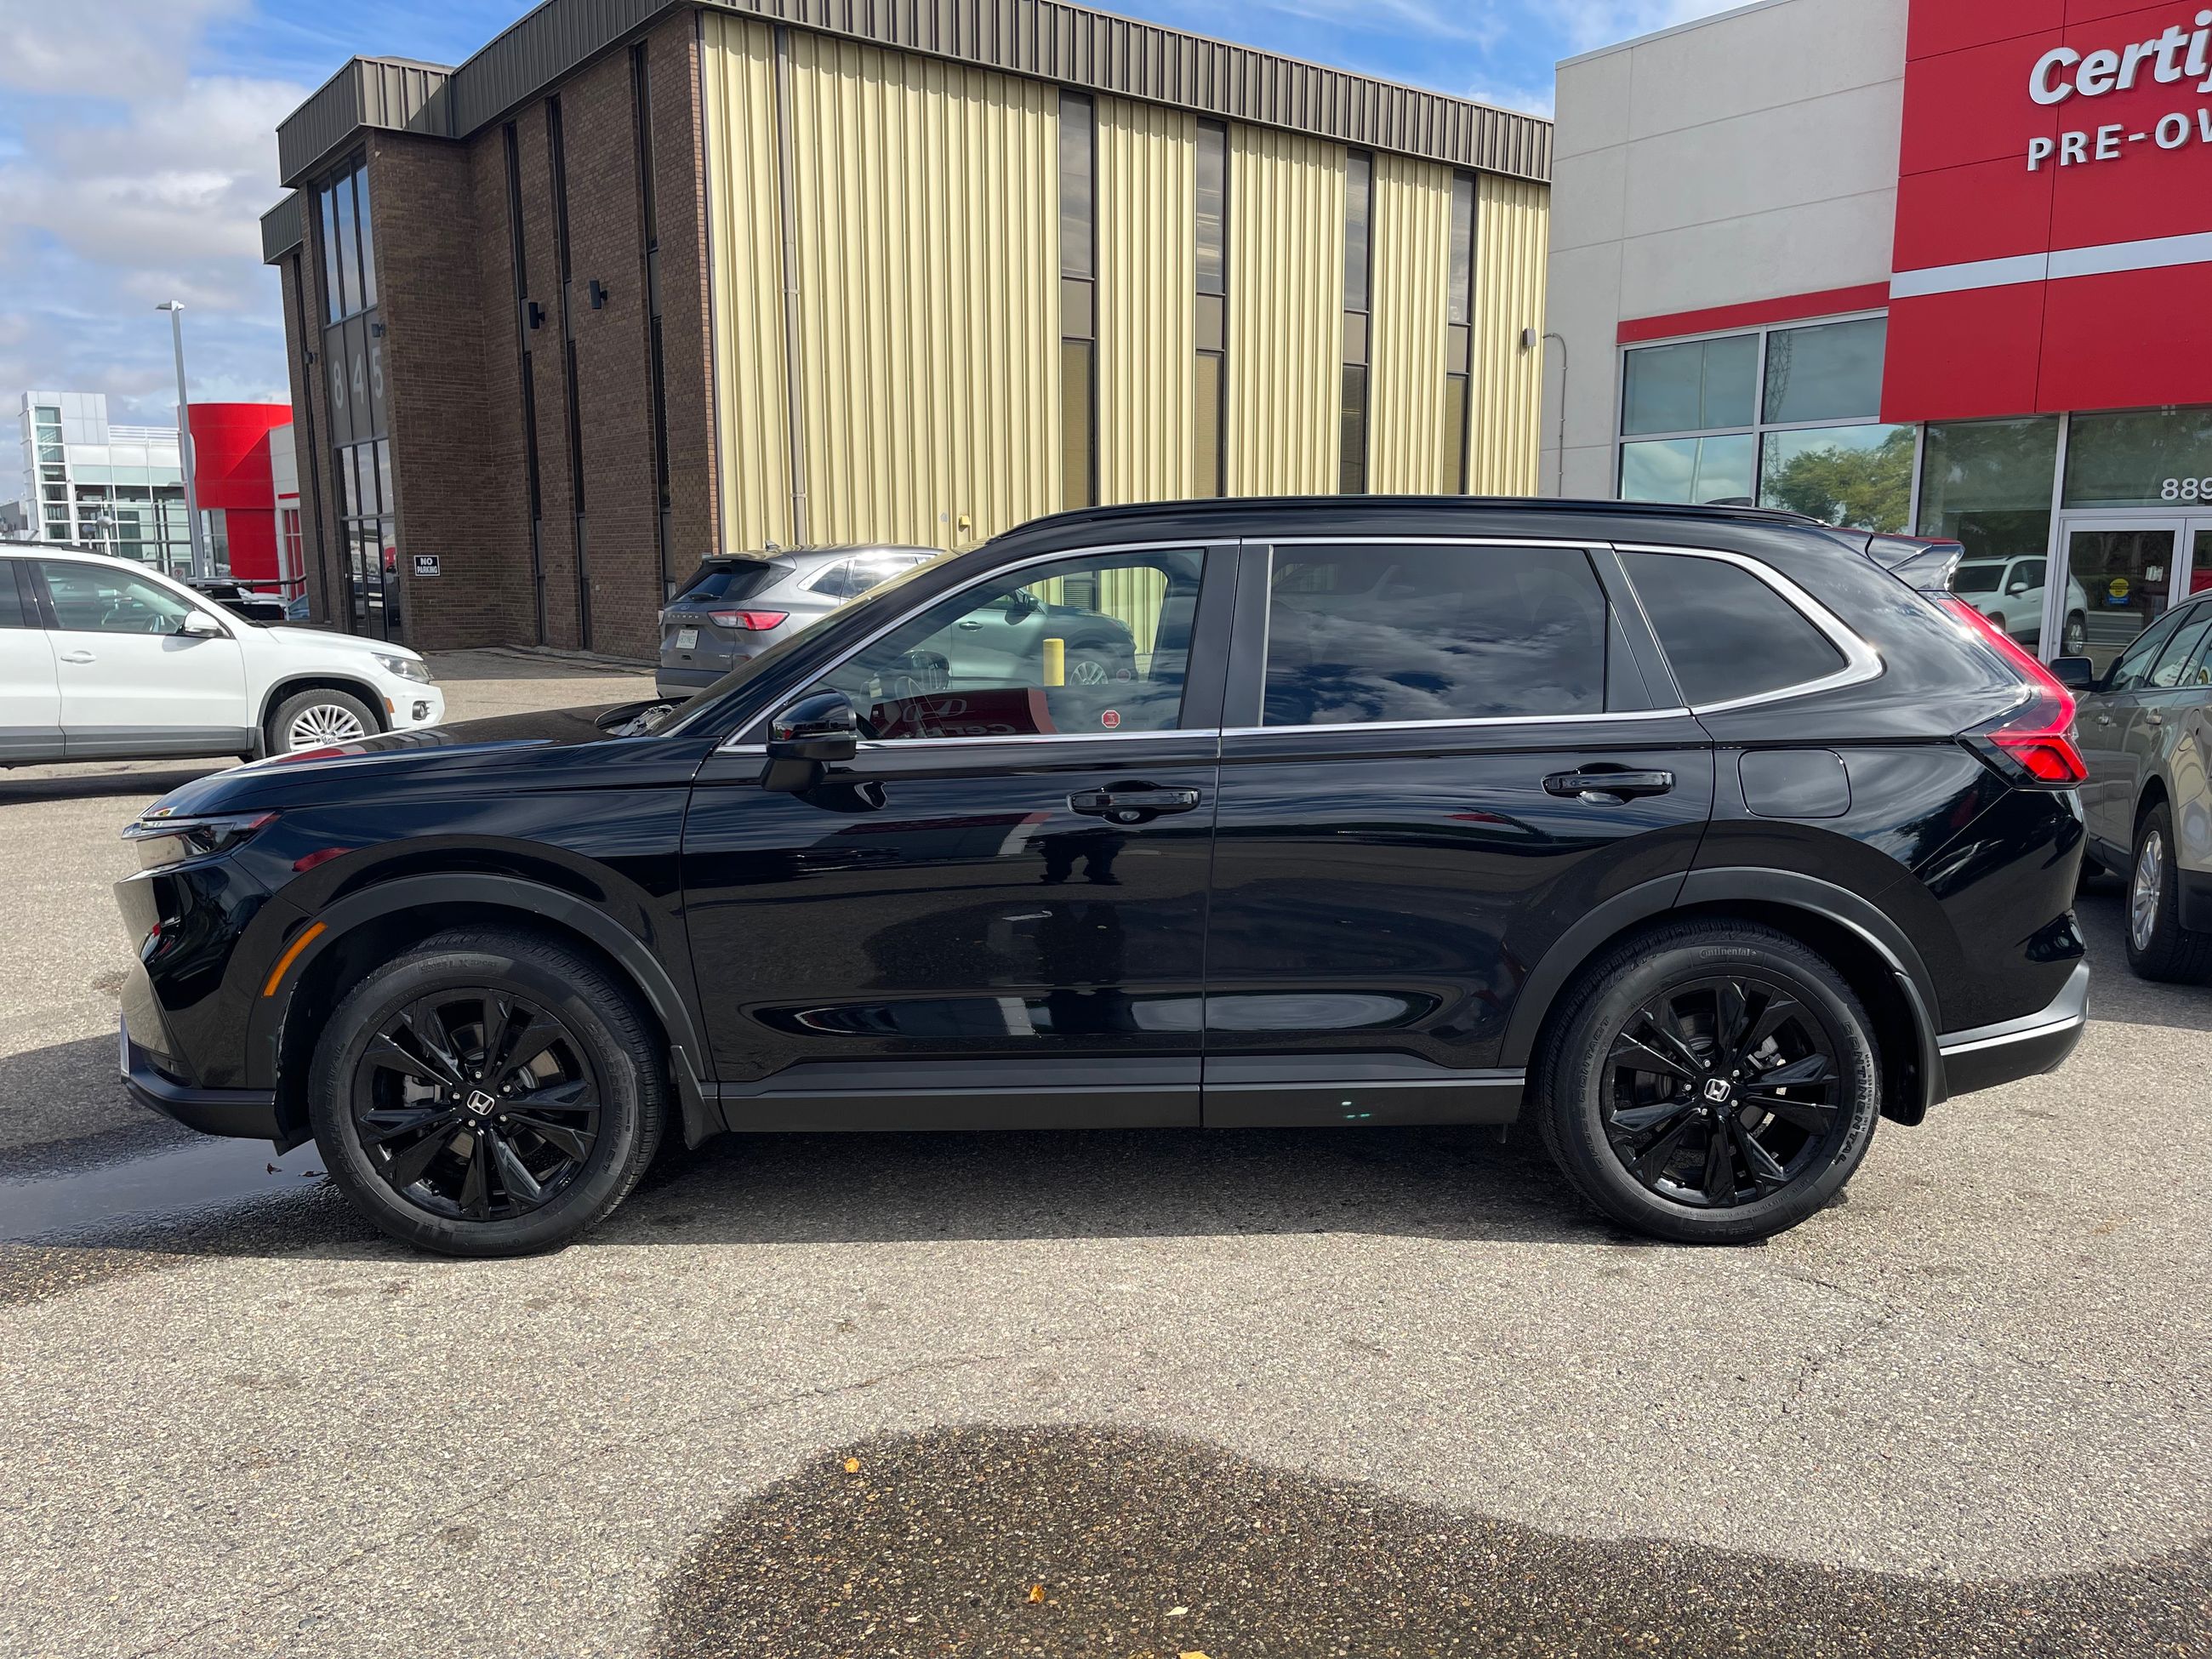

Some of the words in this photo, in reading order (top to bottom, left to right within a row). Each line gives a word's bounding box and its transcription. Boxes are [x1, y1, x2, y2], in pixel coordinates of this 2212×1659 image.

[420, 557, 433, 566] NO
[417, 565, 438, 574] PARKING
[1699, 947, 1751, 959] Continental
[1834, 1021, 1867, 1166] CONTINENTAL
